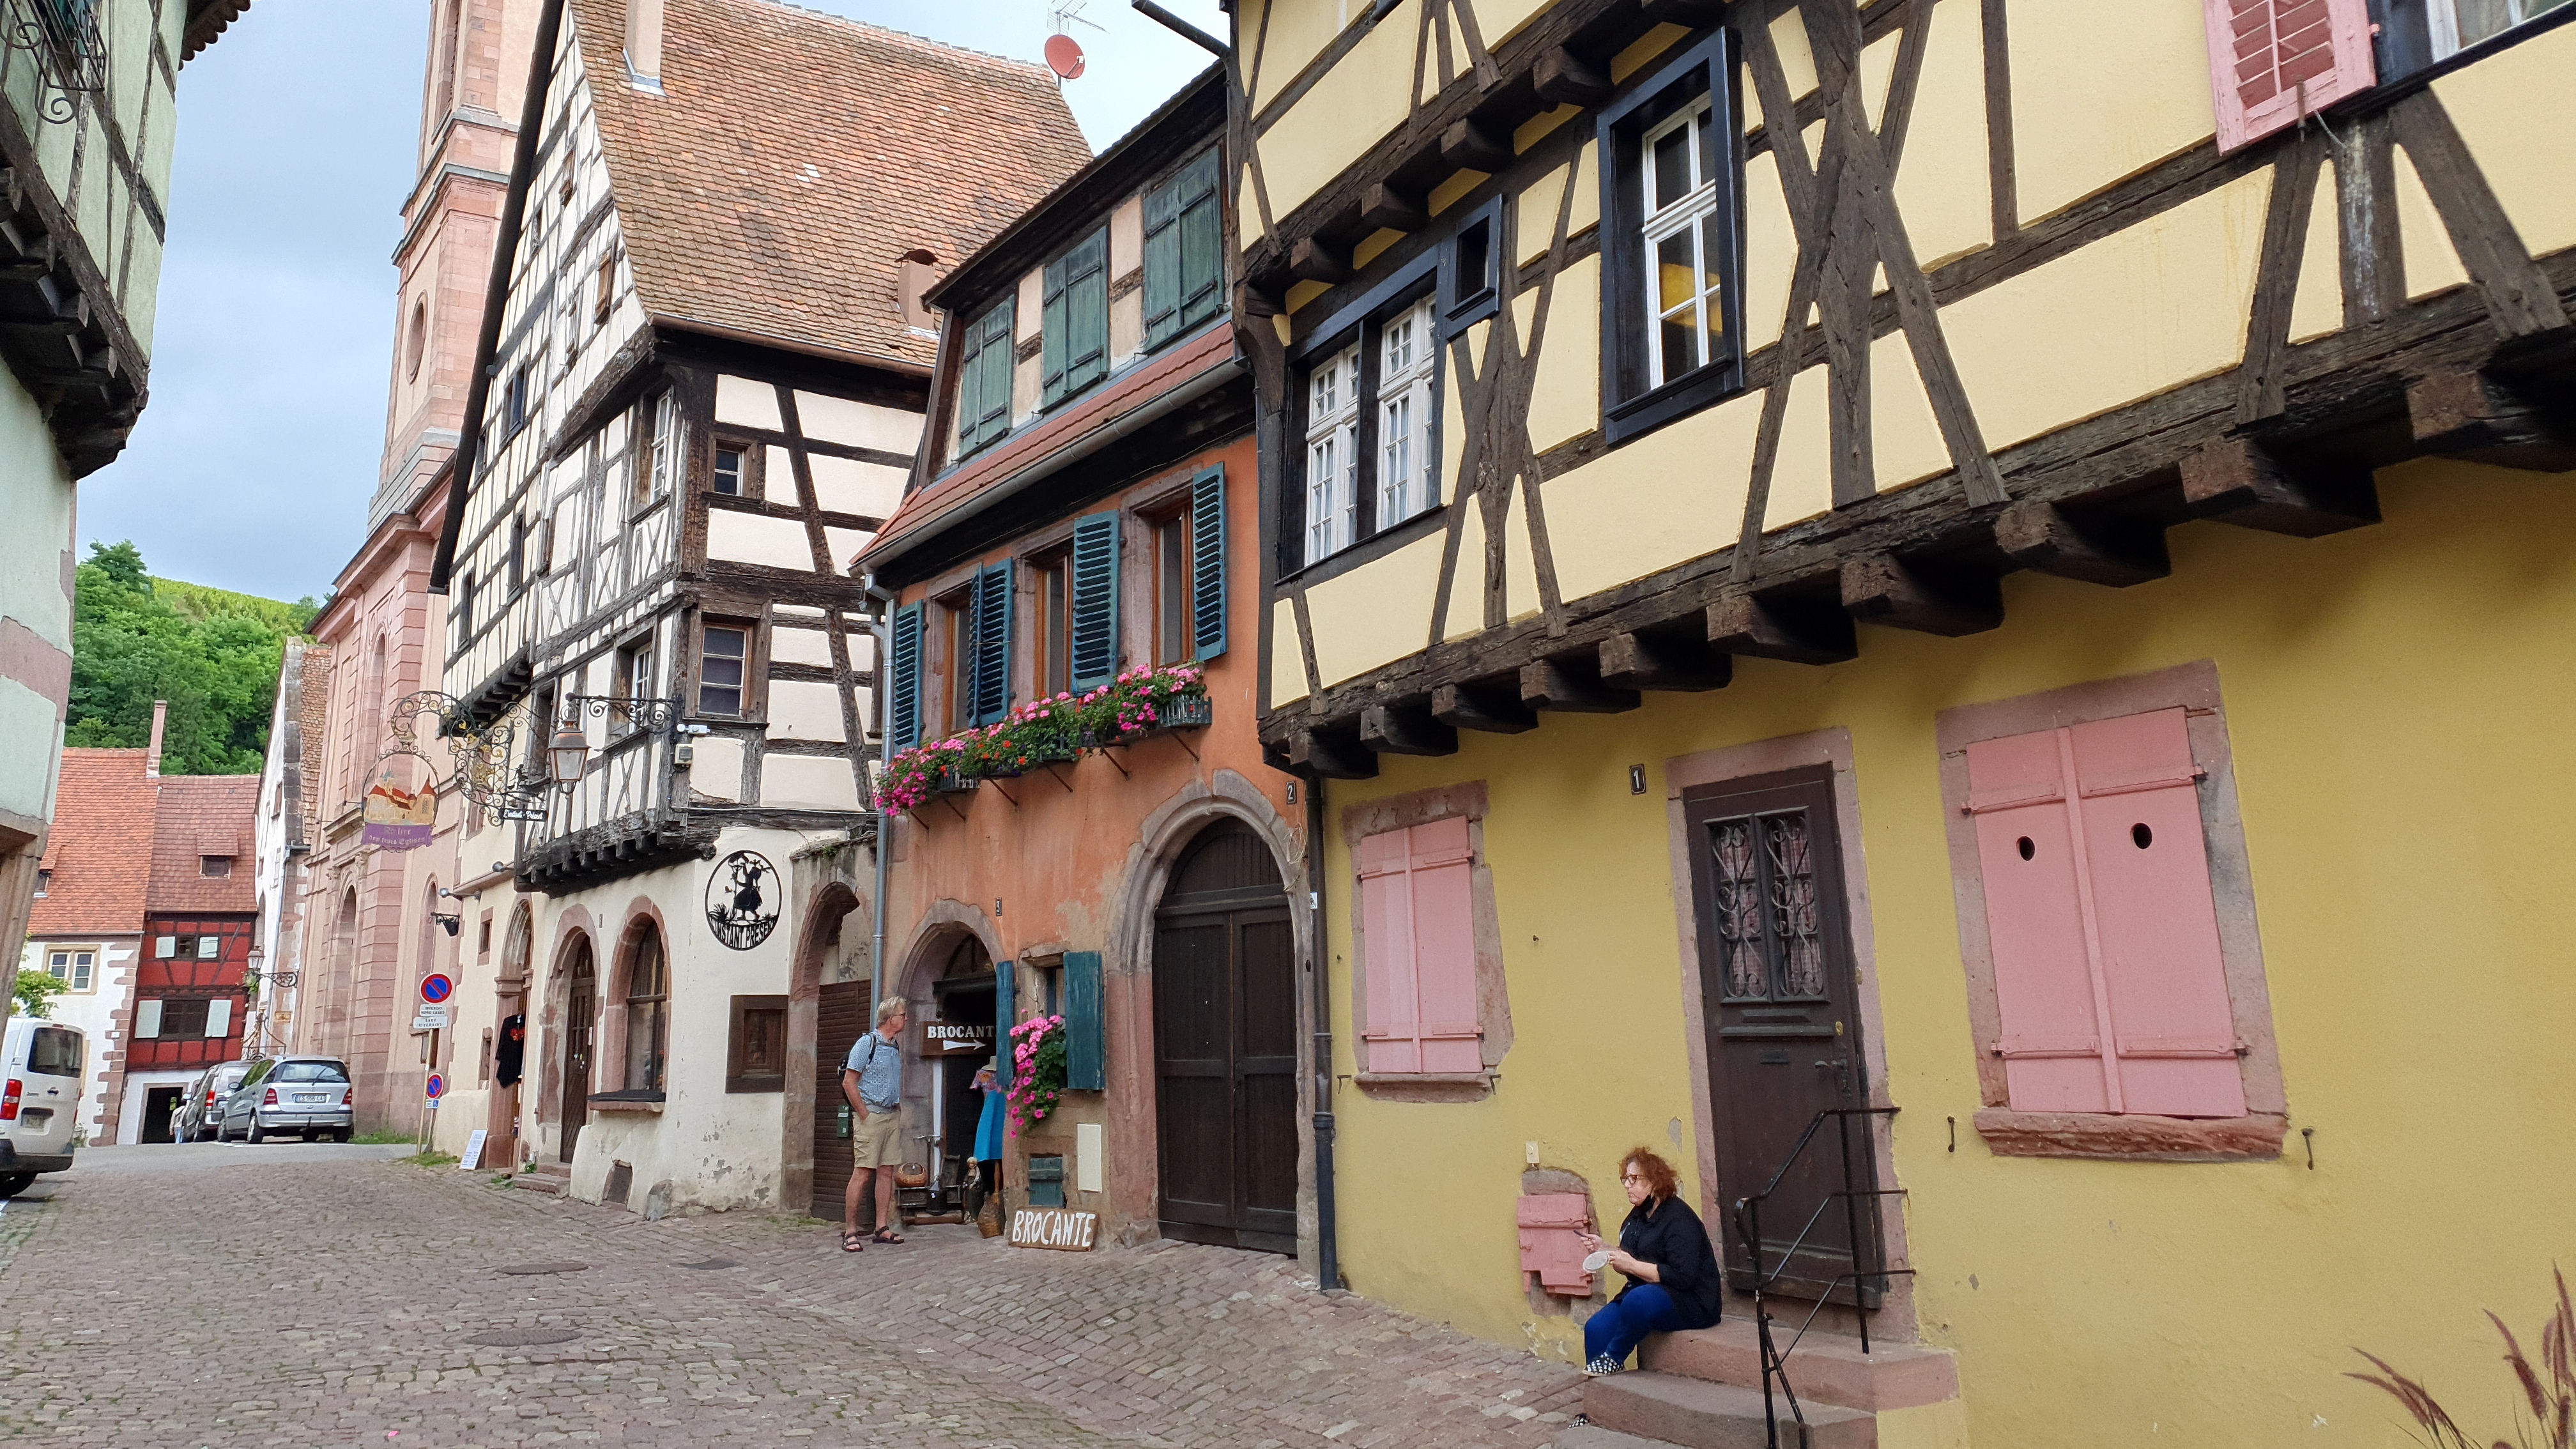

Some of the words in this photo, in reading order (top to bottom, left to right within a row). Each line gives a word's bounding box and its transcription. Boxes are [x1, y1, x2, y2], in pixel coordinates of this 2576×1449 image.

[1287, 785, 1294, 800] 2
[927, 1025, 996, 1038] BROCANT
[1012, 1210, 1096, 1247] BROCANTE
